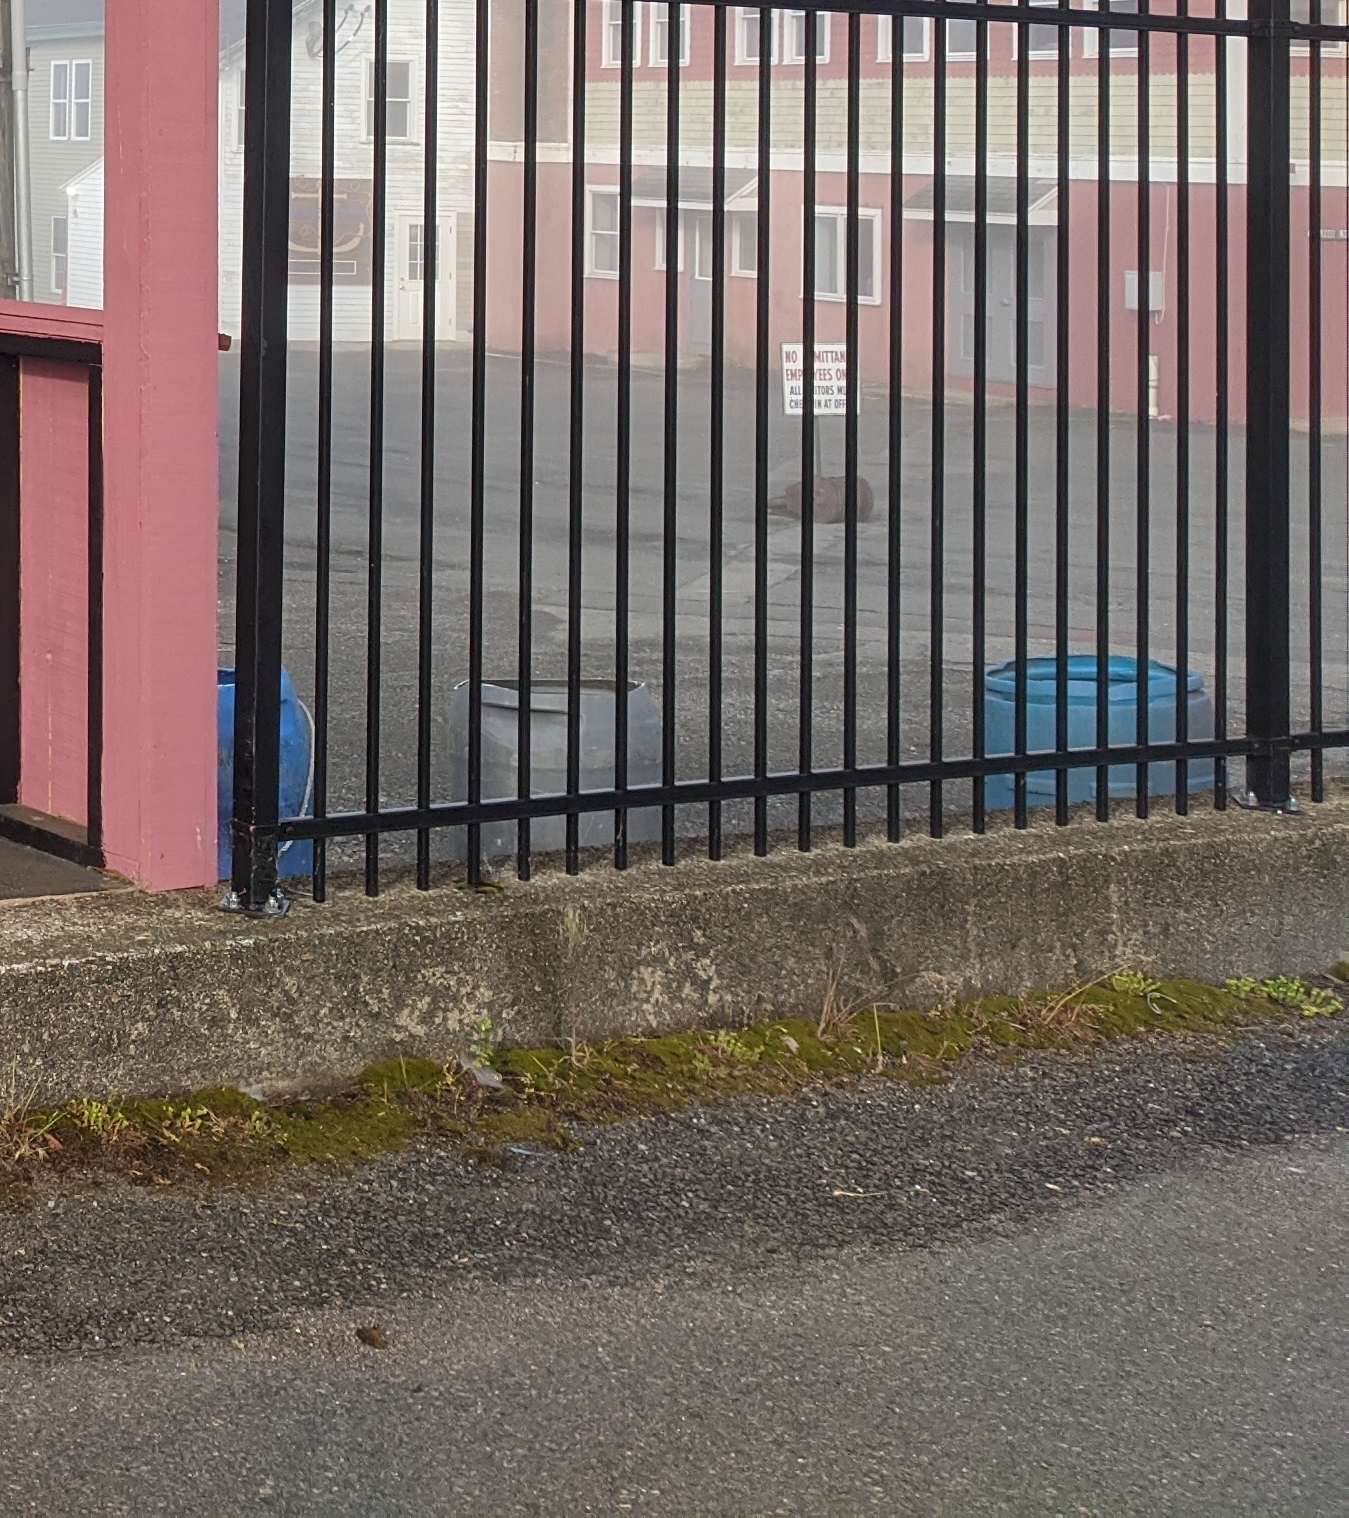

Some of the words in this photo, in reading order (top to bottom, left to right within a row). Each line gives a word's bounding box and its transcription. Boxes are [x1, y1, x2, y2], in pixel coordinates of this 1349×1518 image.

[785, 350, 798, 363] NO
[785, 368, 833, 382] EMPYEES
[789, 385, 802, 396] ALL
[823, 399, 832, 409] AT
